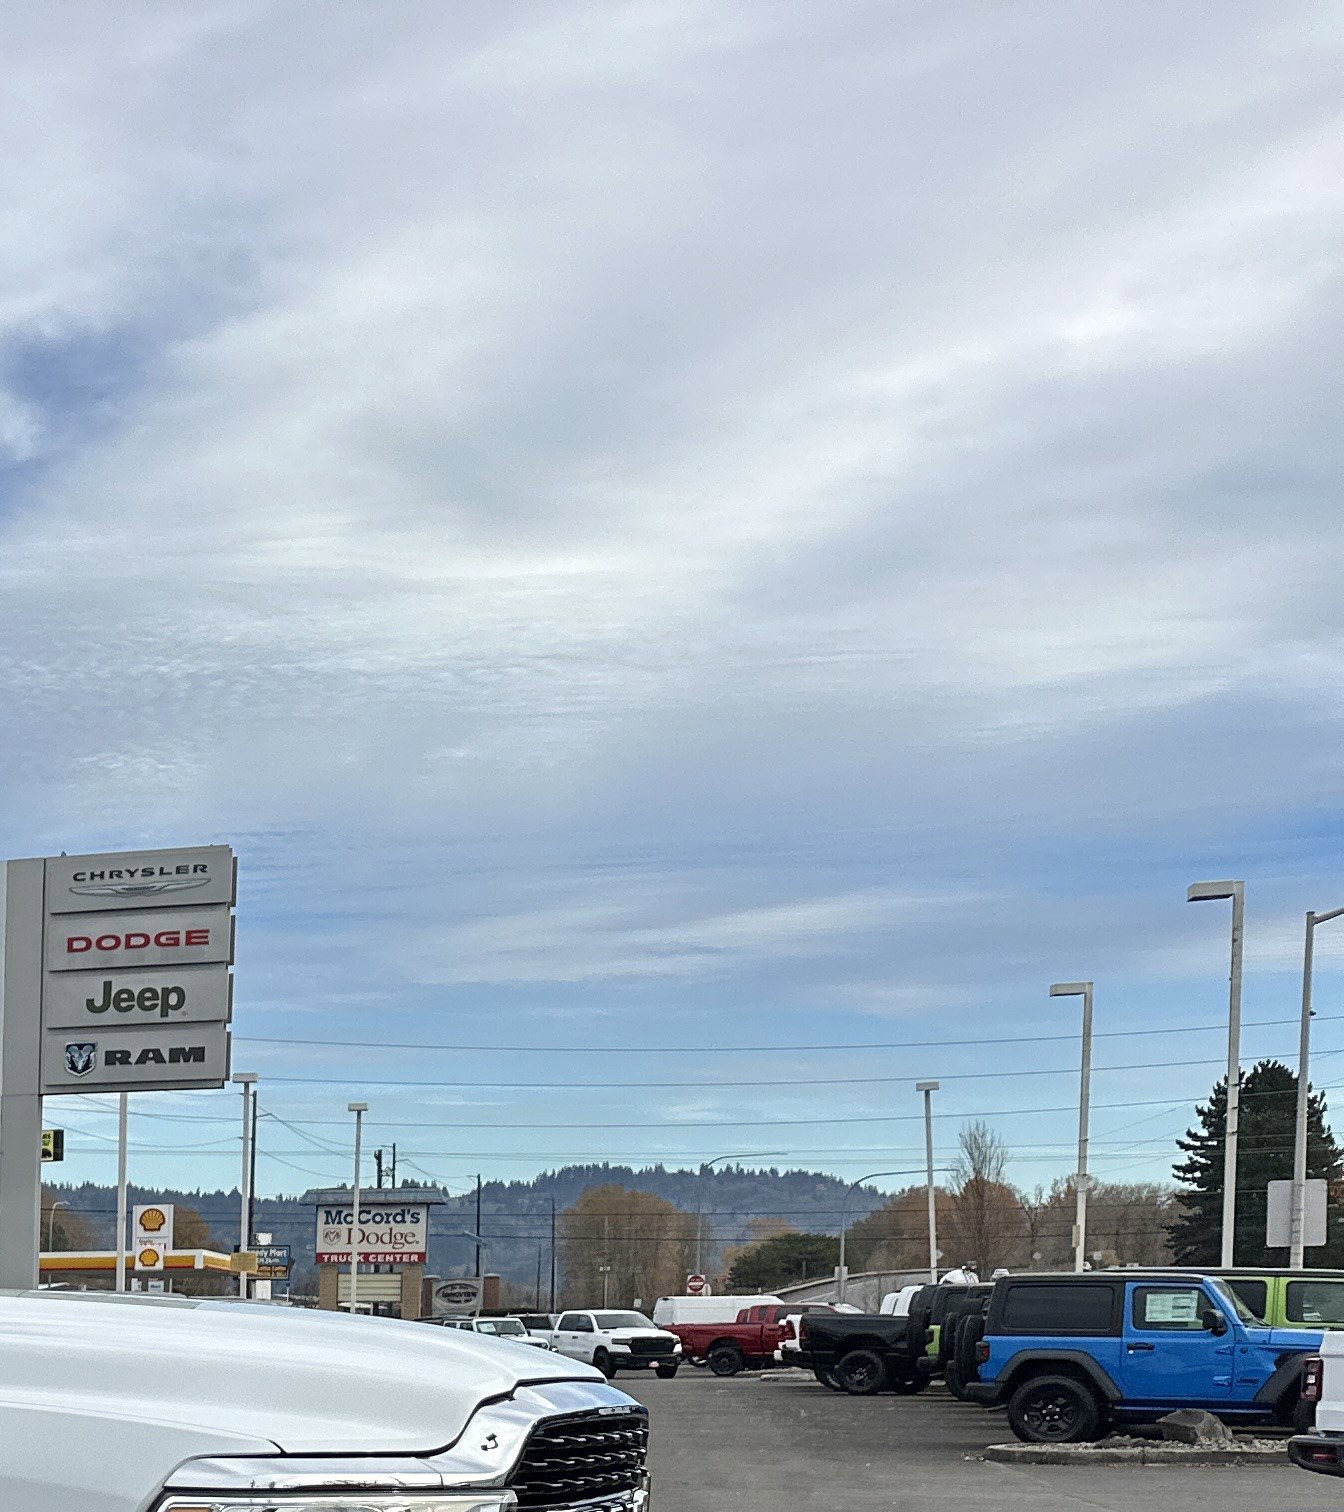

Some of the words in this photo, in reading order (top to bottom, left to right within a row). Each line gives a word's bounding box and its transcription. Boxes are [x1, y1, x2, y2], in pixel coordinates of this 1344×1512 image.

[72, 863, 208, 882] CHRYSLER
[67, 929, 210, 953] DODGE
[86, 981, 186, 1018] Jeep
[104, 1046, 205, 1066] RAM
[324, 1208, 421, 1225] McCord's
[368, 1253, 419, 1263] CENTER
